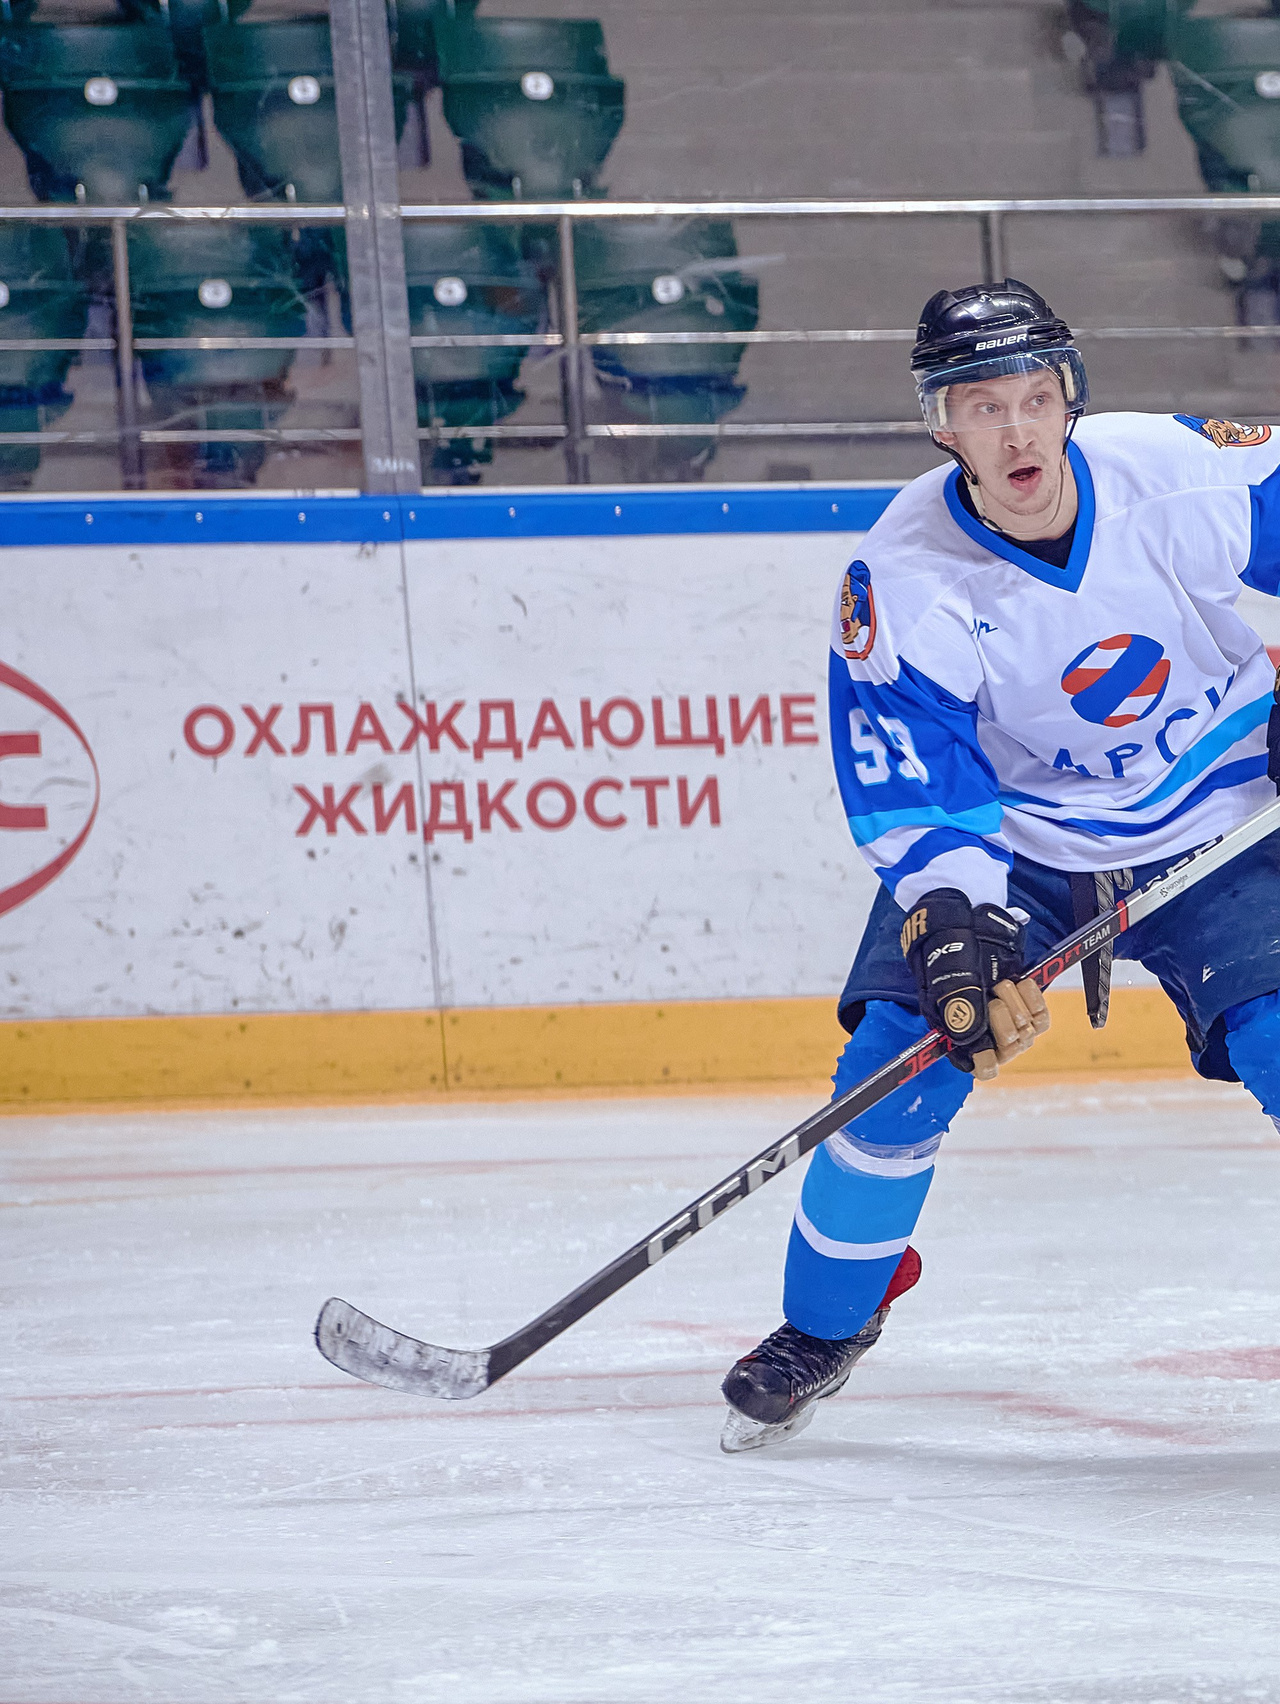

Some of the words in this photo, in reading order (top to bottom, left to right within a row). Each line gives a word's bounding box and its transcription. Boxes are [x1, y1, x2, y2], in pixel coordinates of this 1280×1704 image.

[974, 333, 1028, 352] BAUER
[183, 693, 820, 761] ОХЛАЖДАЮЩИЕ
[293, 774, 723, 843] ЖИДКОСТИ
[1082, 924, 1111, 951] TEAM
[648, 1133, 800, 1265] CCM
